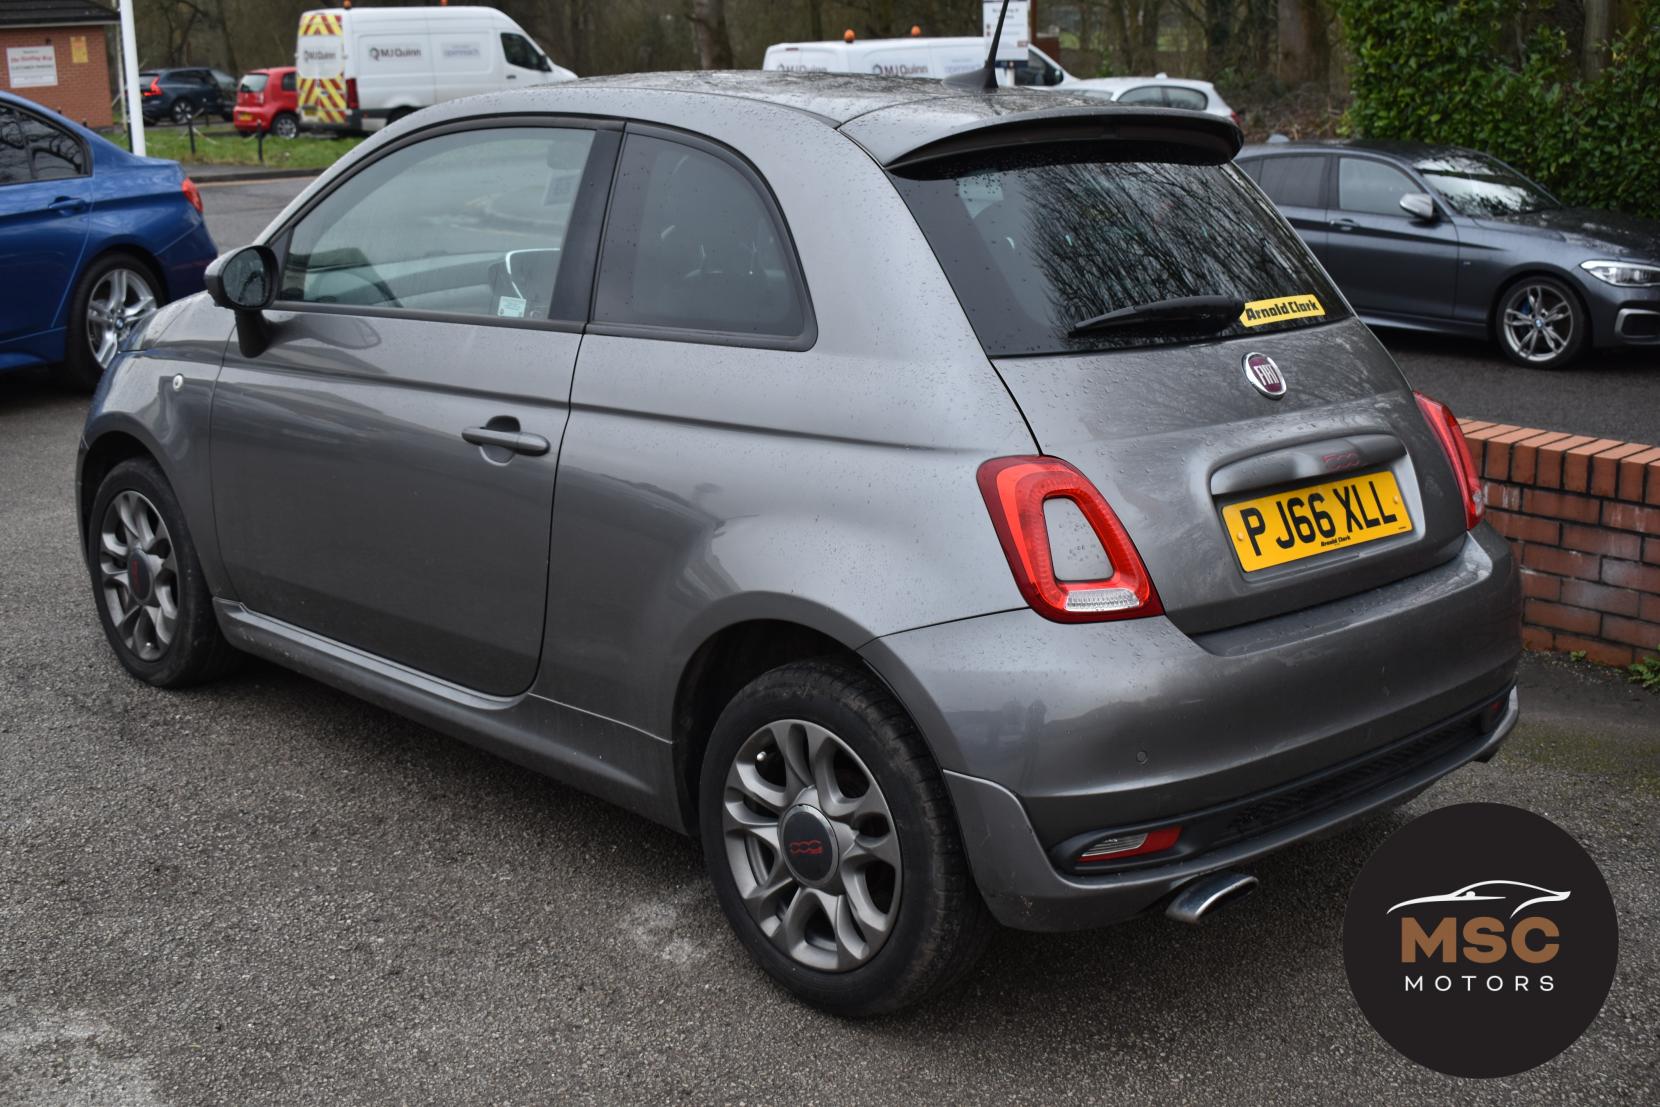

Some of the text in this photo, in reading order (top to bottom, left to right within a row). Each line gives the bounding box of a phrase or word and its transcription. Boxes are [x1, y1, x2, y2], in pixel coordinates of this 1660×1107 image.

[1246, 300, 1319, 321] Arnold Clark
[1253, 364, 1280, 386] FIAT
[1240, 481, 1398, 556] PJ66 XLL
